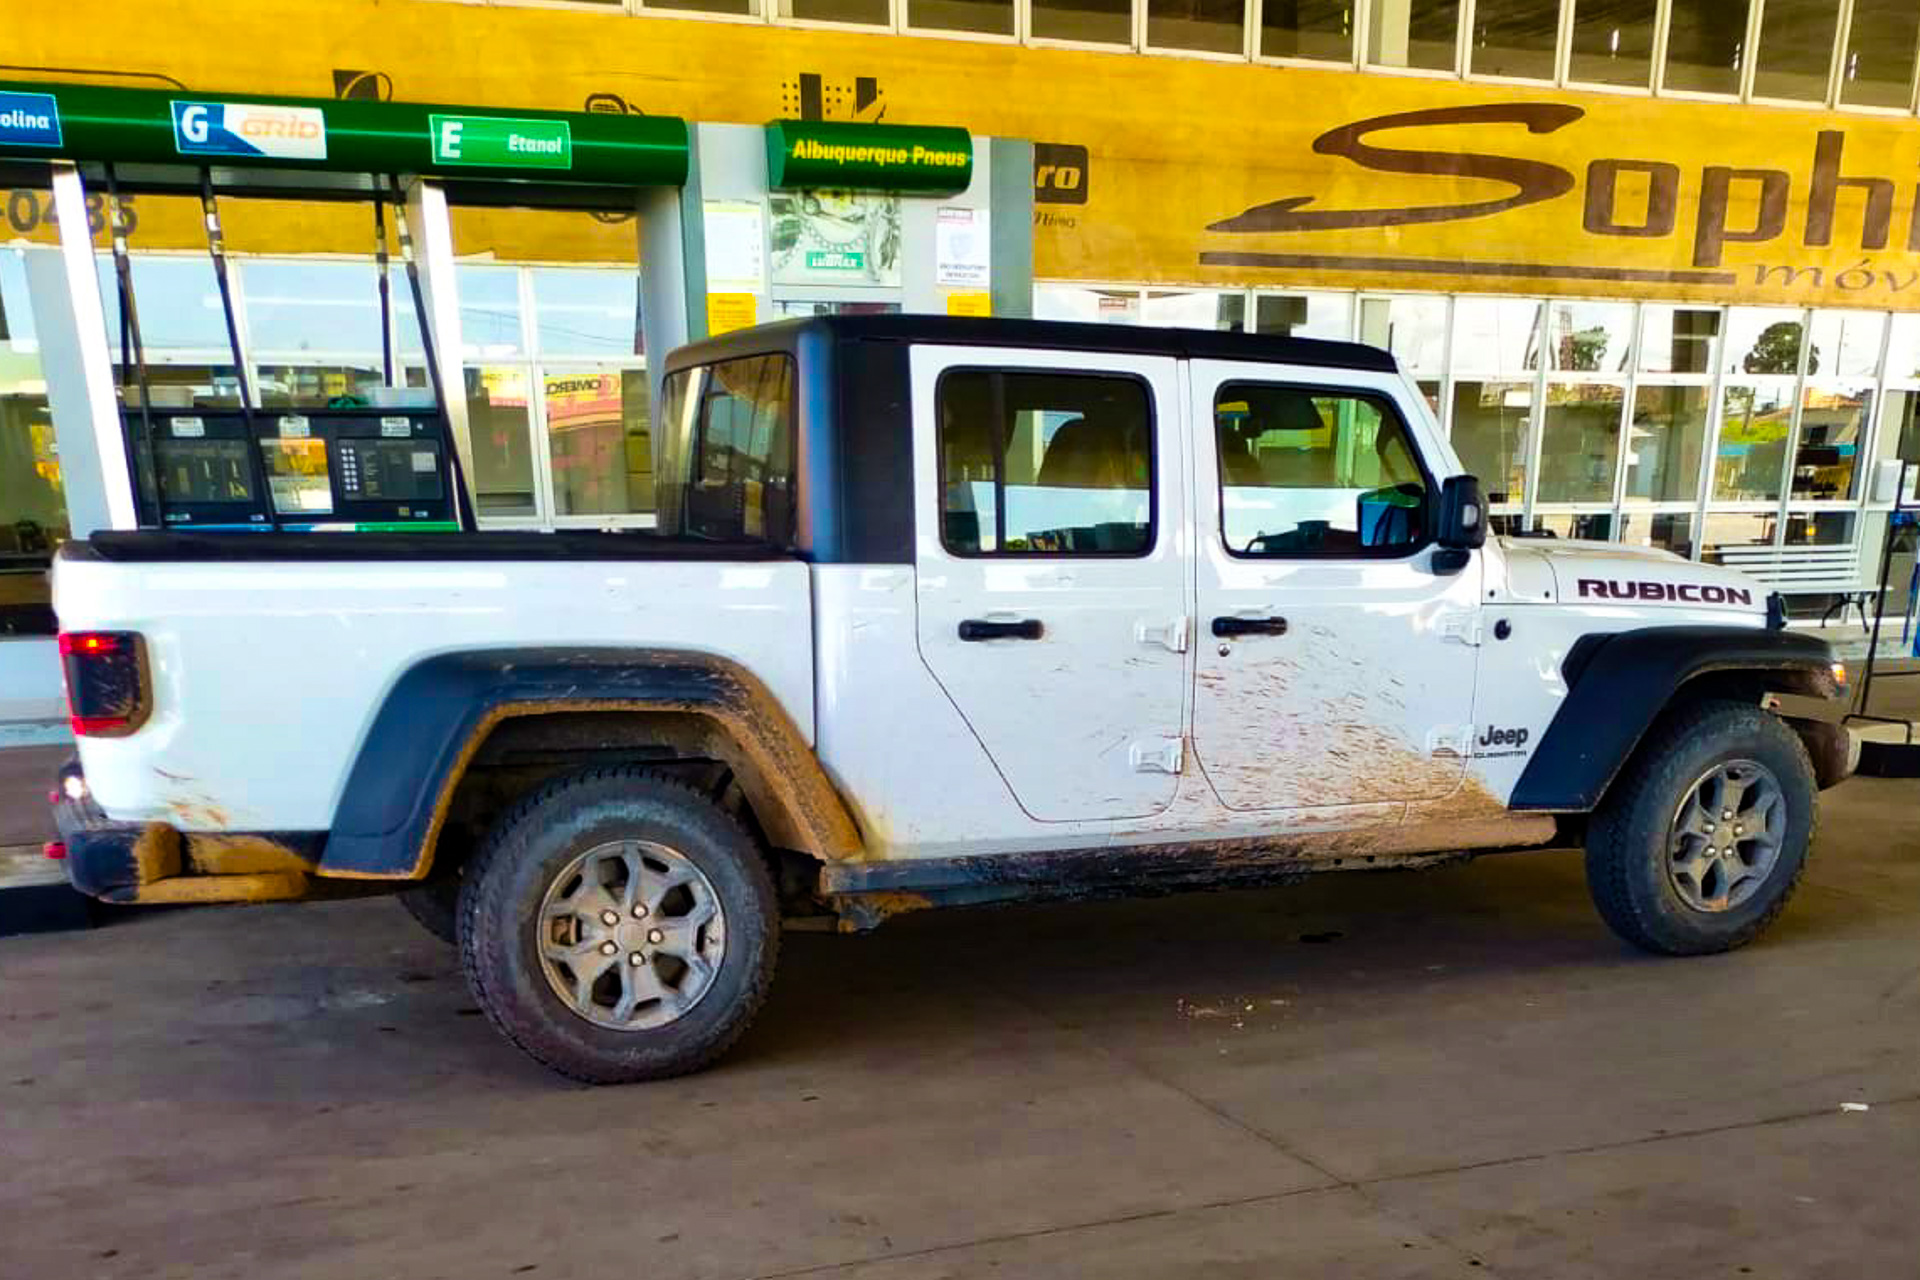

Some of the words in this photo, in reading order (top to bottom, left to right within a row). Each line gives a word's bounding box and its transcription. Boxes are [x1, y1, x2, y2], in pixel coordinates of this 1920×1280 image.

[0, 110, 50, 129] olina
[179, 105, 208, 143] G
[440, 121, 463, 158] E
[508, 134, 562, 154] Etanol
[792, 138, 908, 166] Albuquerque
[912, 145, 968, 167] Pneus
[1578, 579, 1752, 605] RUBICON
[1479, 725, 1528, 748] Jeep
